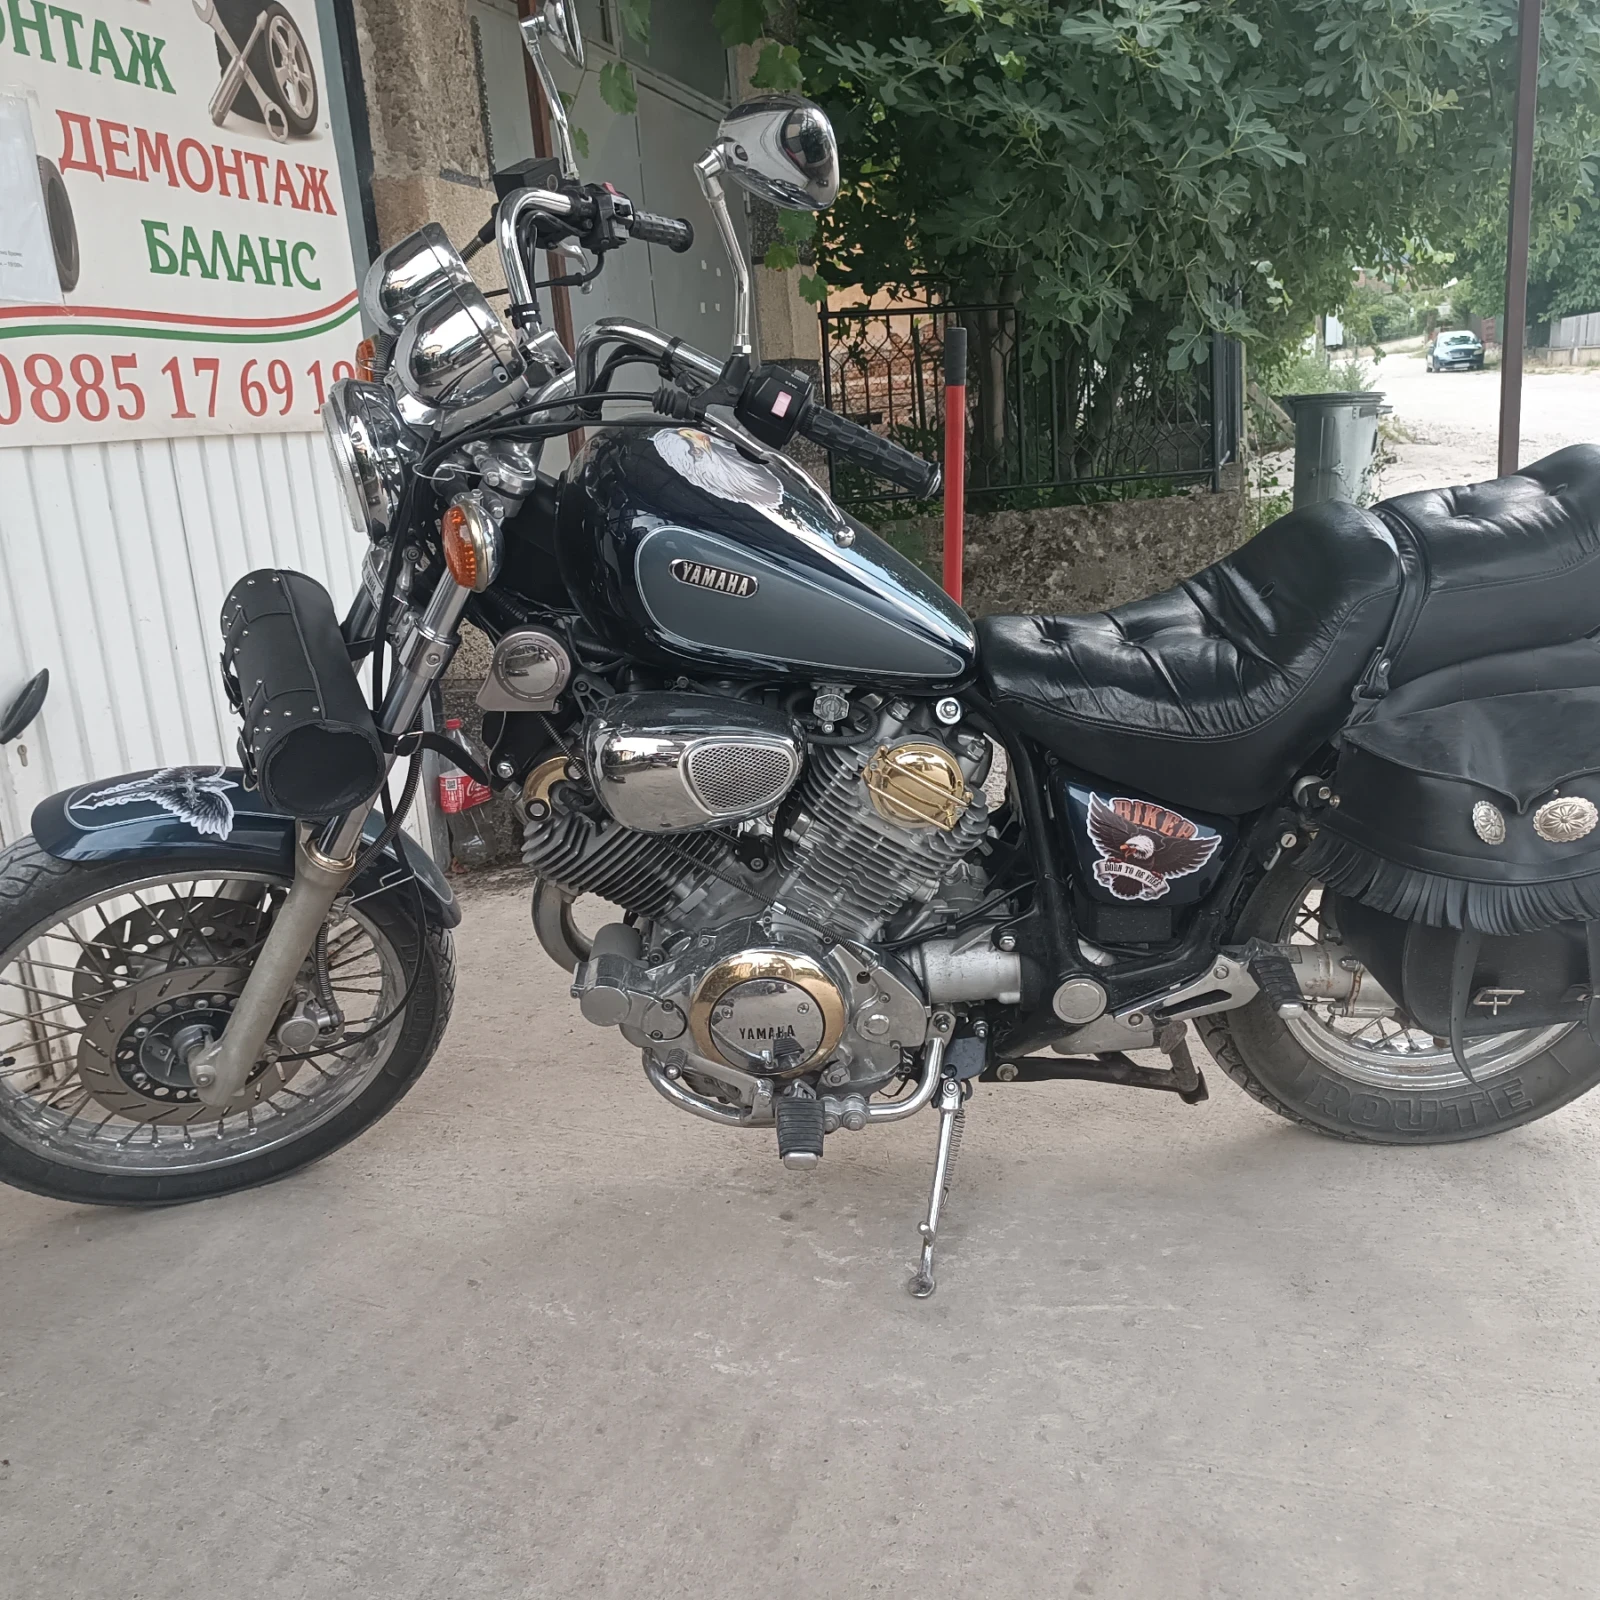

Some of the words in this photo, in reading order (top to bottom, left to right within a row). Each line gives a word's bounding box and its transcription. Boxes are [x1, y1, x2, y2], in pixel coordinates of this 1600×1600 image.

[0, 0, 177, 95] НТАЖ
[55, 109, 338, 216] ДЕМОНТАЖ
[140, 219, 322, 291] БАЛАНС
[161, 356, 220, 419] 17
[240, 358, 294, 417] 69
[682, 561, 750, 596] YAMAHA
[1114, 800, 1196, 839] BIKER
[738, 1024, 797, 1040] YAMAHA
[1304, 1074, 1535, 1131] ROUTE
